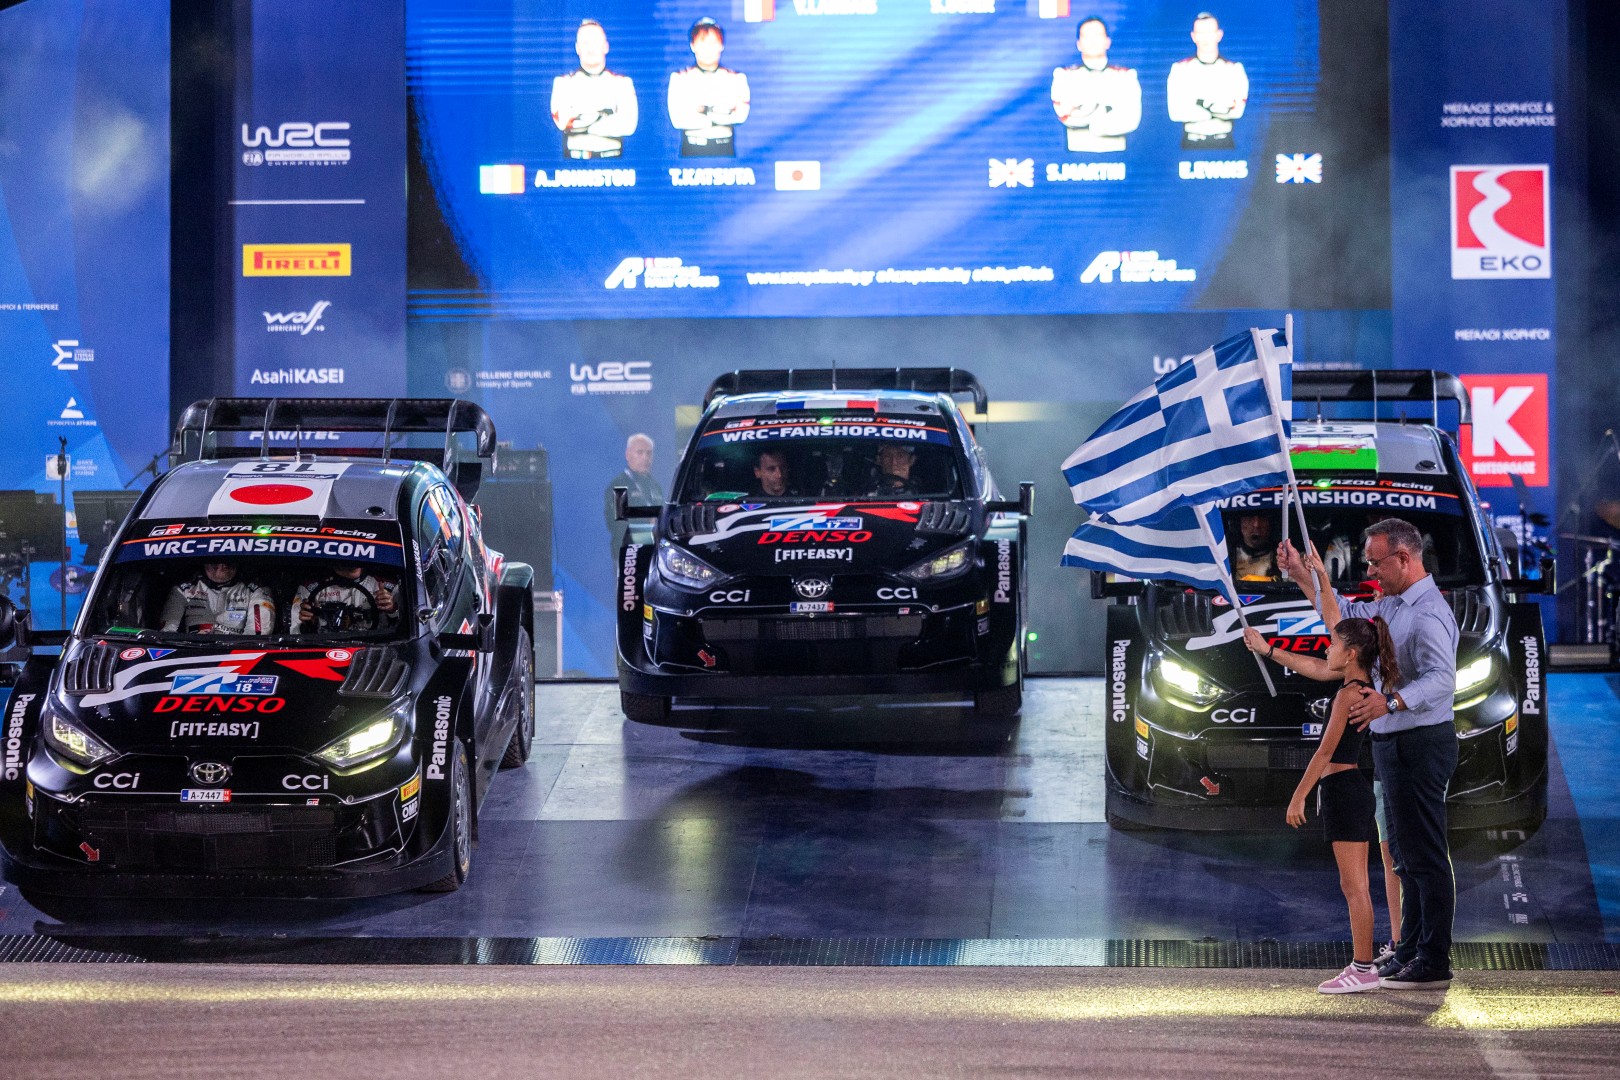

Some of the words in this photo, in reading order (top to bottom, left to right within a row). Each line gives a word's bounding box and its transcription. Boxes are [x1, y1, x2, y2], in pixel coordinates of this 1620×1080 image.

[242, 122, 350, 147] WRC
[243, 152, 263, 164] FIA
[254, 251, 341, 270] PIRELLI
[1480, 256, 1542, 271] EKO
[251, 368, 344, 384] AsahiKASEI
[570, 361, 652, 381] WRC
[722, 426, 927, 443] WRC-FANSHOP.COM
[1379, 480, 1434, 492] Racing
[187, 525, 252, 533] TOYOTA
[320, 527, 377, 539] Racing
[757, 531, 873, 544] DENSO
[144, 538, 376, 559] WRC-FANSHOP.COM
[1267, 637, 1332, 652] DEN
[1112, 639, 1131, 723] Panasonic
[1520, 635, 1540, 715] Panasonic
[235, 683, 253, 693] 18
[153, 697, 286, 713] DENSO
[5, 693, 36, 781] Panasonic
[426, 695, 452, 780] Panasonic
[190, 791, 221, 800] A-7447
[402, 800, 418, 819] OMP
